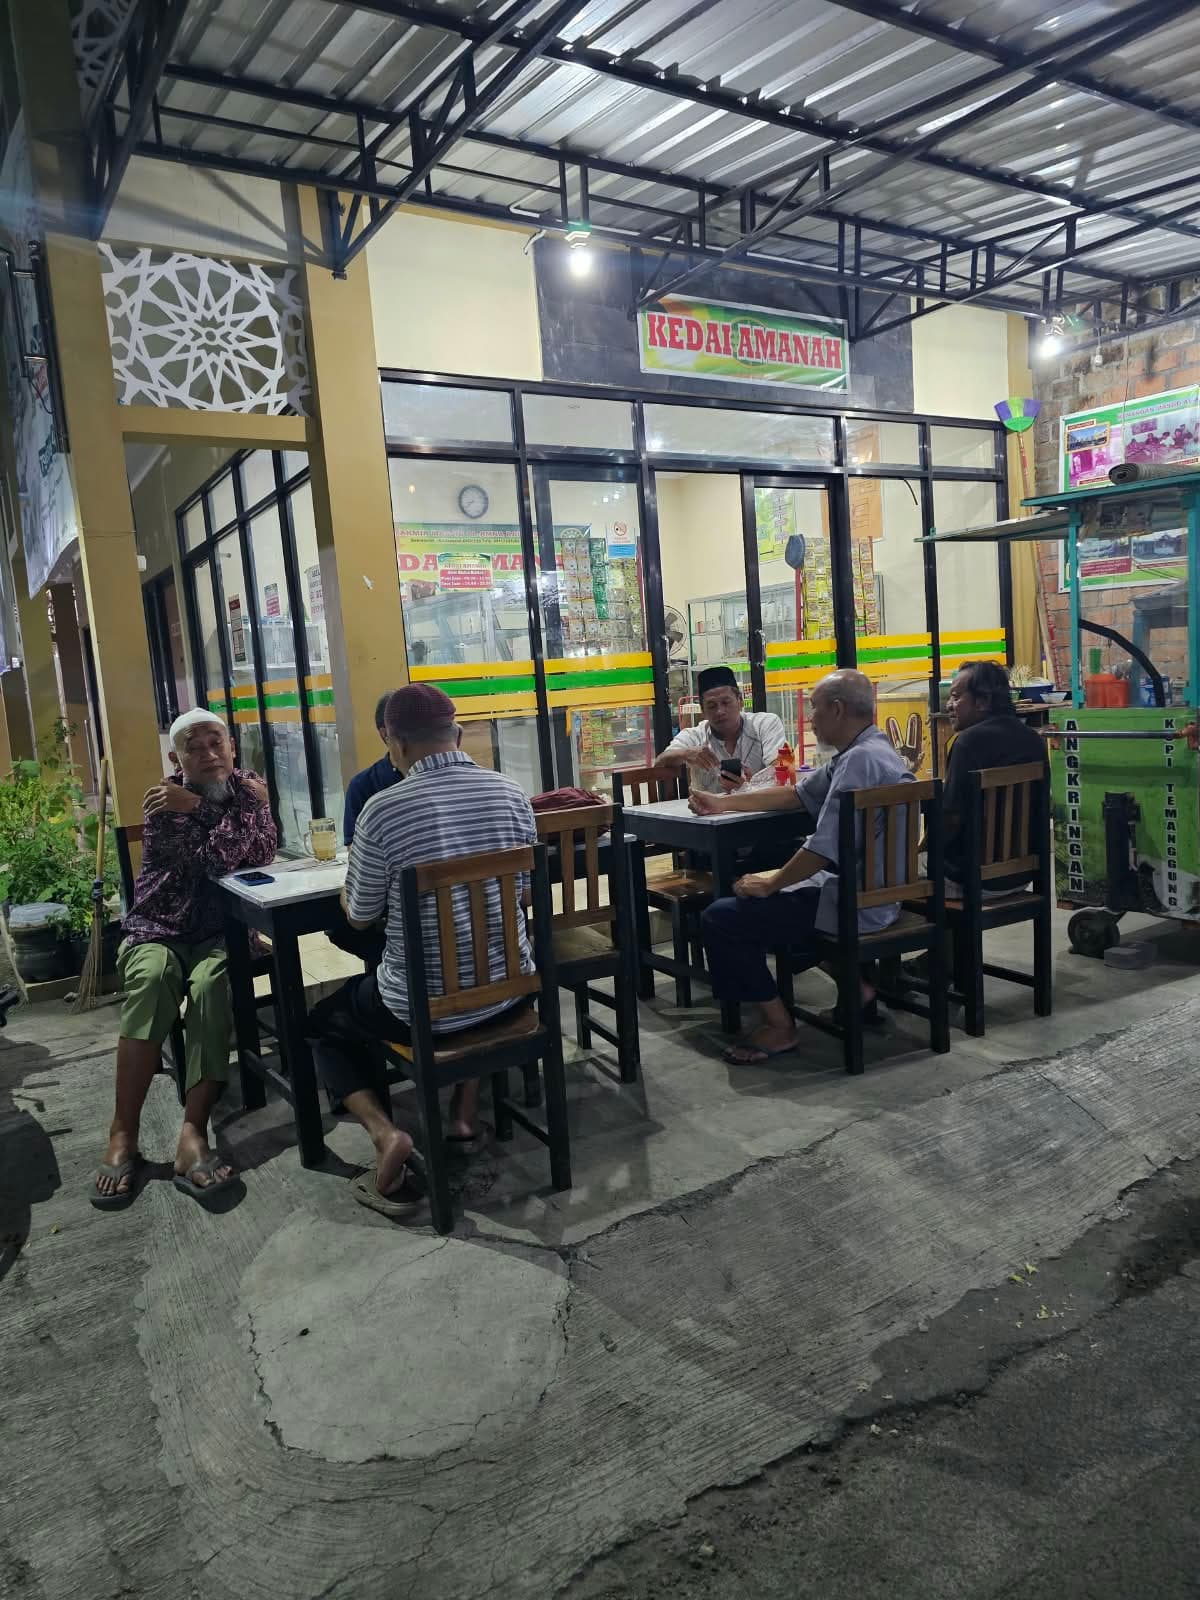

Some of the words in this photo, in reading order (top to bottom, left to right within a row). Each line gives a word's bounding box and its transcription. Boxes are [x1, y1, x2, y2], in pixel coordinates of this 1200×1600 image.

[647, 313, 732, 356] KEDAI
[737, 325, 842, 369] AMANAH
[1164, 718, 1175, 767] KPI
[1066, 720, 1083, 891] ANGKRINGAN
[1165, 784, 1177, 906] TEMANGGUNG
